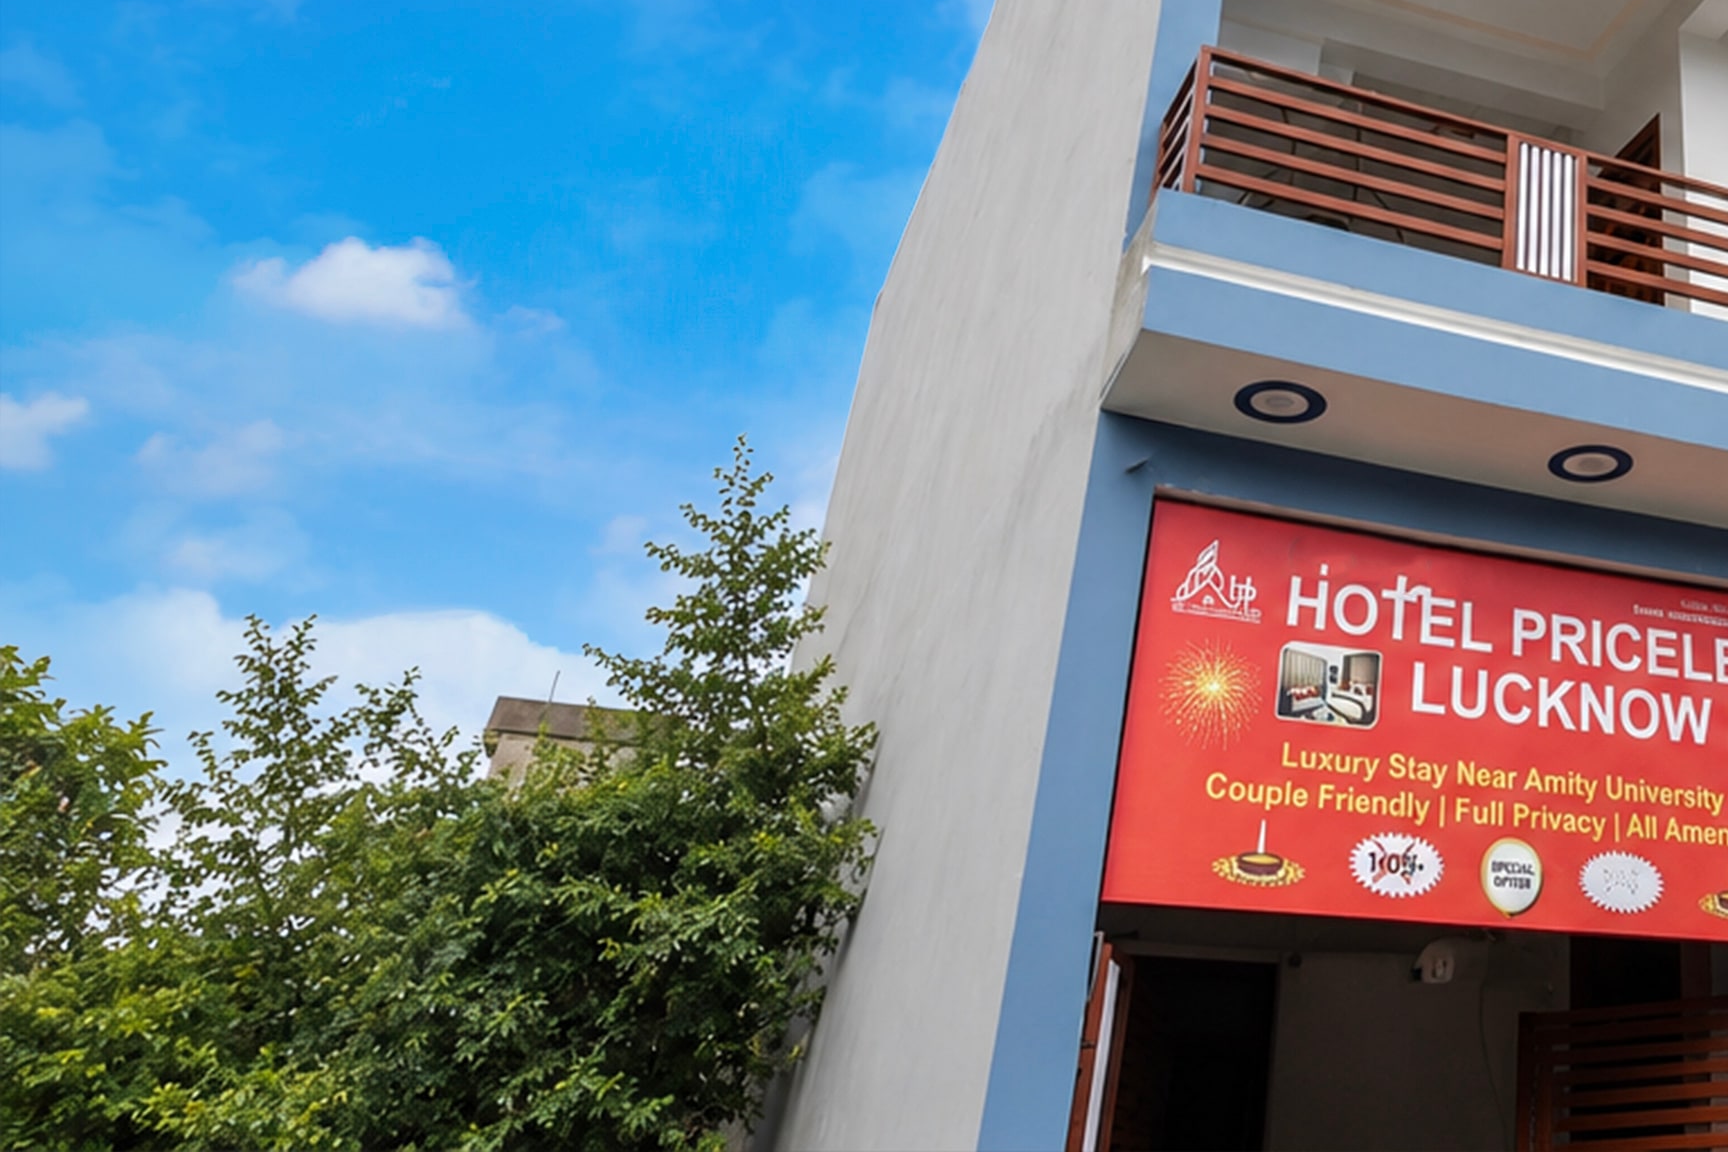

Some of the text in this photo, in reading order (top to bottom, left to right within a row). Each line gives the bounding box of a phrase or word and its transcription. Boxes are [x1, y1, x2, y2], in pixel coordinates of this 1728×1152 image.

[1286, 566, 1493, 652] HOTEL
[1411, 661, 1712, 745] LUCKNOW
[1206, 772, 1308, 810] Couple
[1318, 784, 1430, 826] Friendly
[1455, 798, 1504, 826] Full
[1513, 803, 1606, 842] Privacy
[1626, 813, 1658, 840] All
[1281, 742, 1724, 816] Luxury Stay Near Amity University
